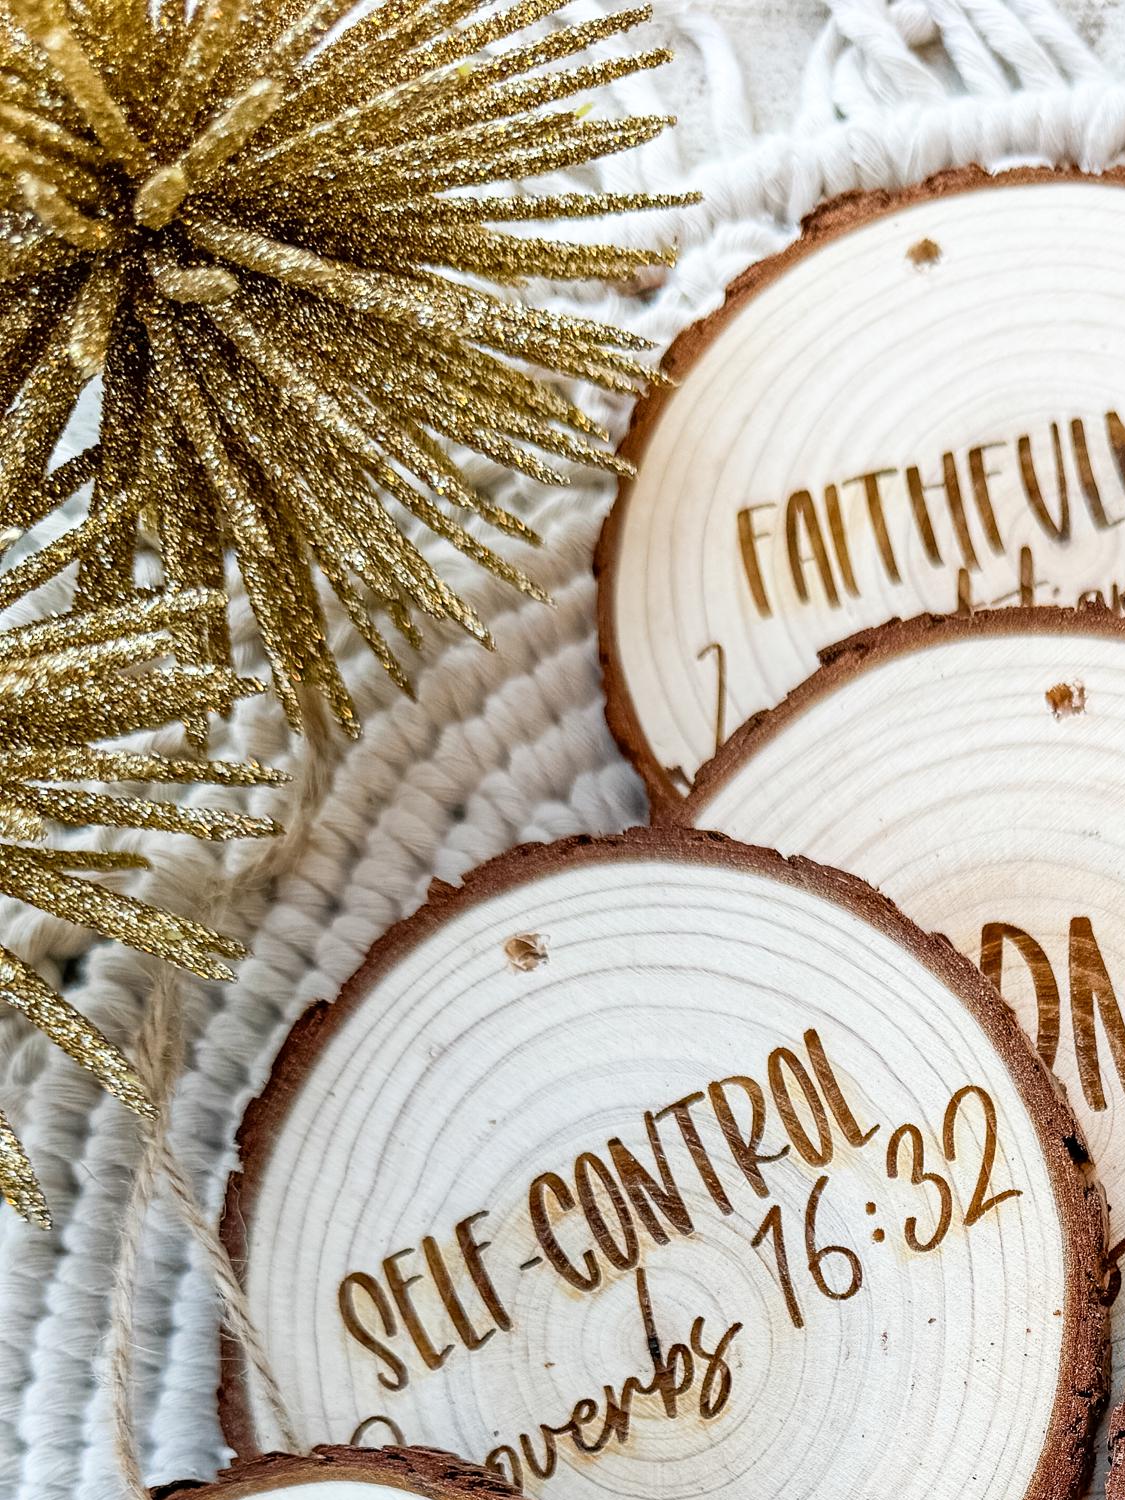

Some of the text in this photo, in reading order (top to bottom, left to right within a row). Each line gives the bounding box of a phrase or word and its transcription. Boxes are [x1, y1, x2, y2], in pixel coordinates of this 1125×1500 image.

[337, 1028, 879, 1392] SELF-CONTROL
[351, 1085, 1023, 1495] overbs 16:32
